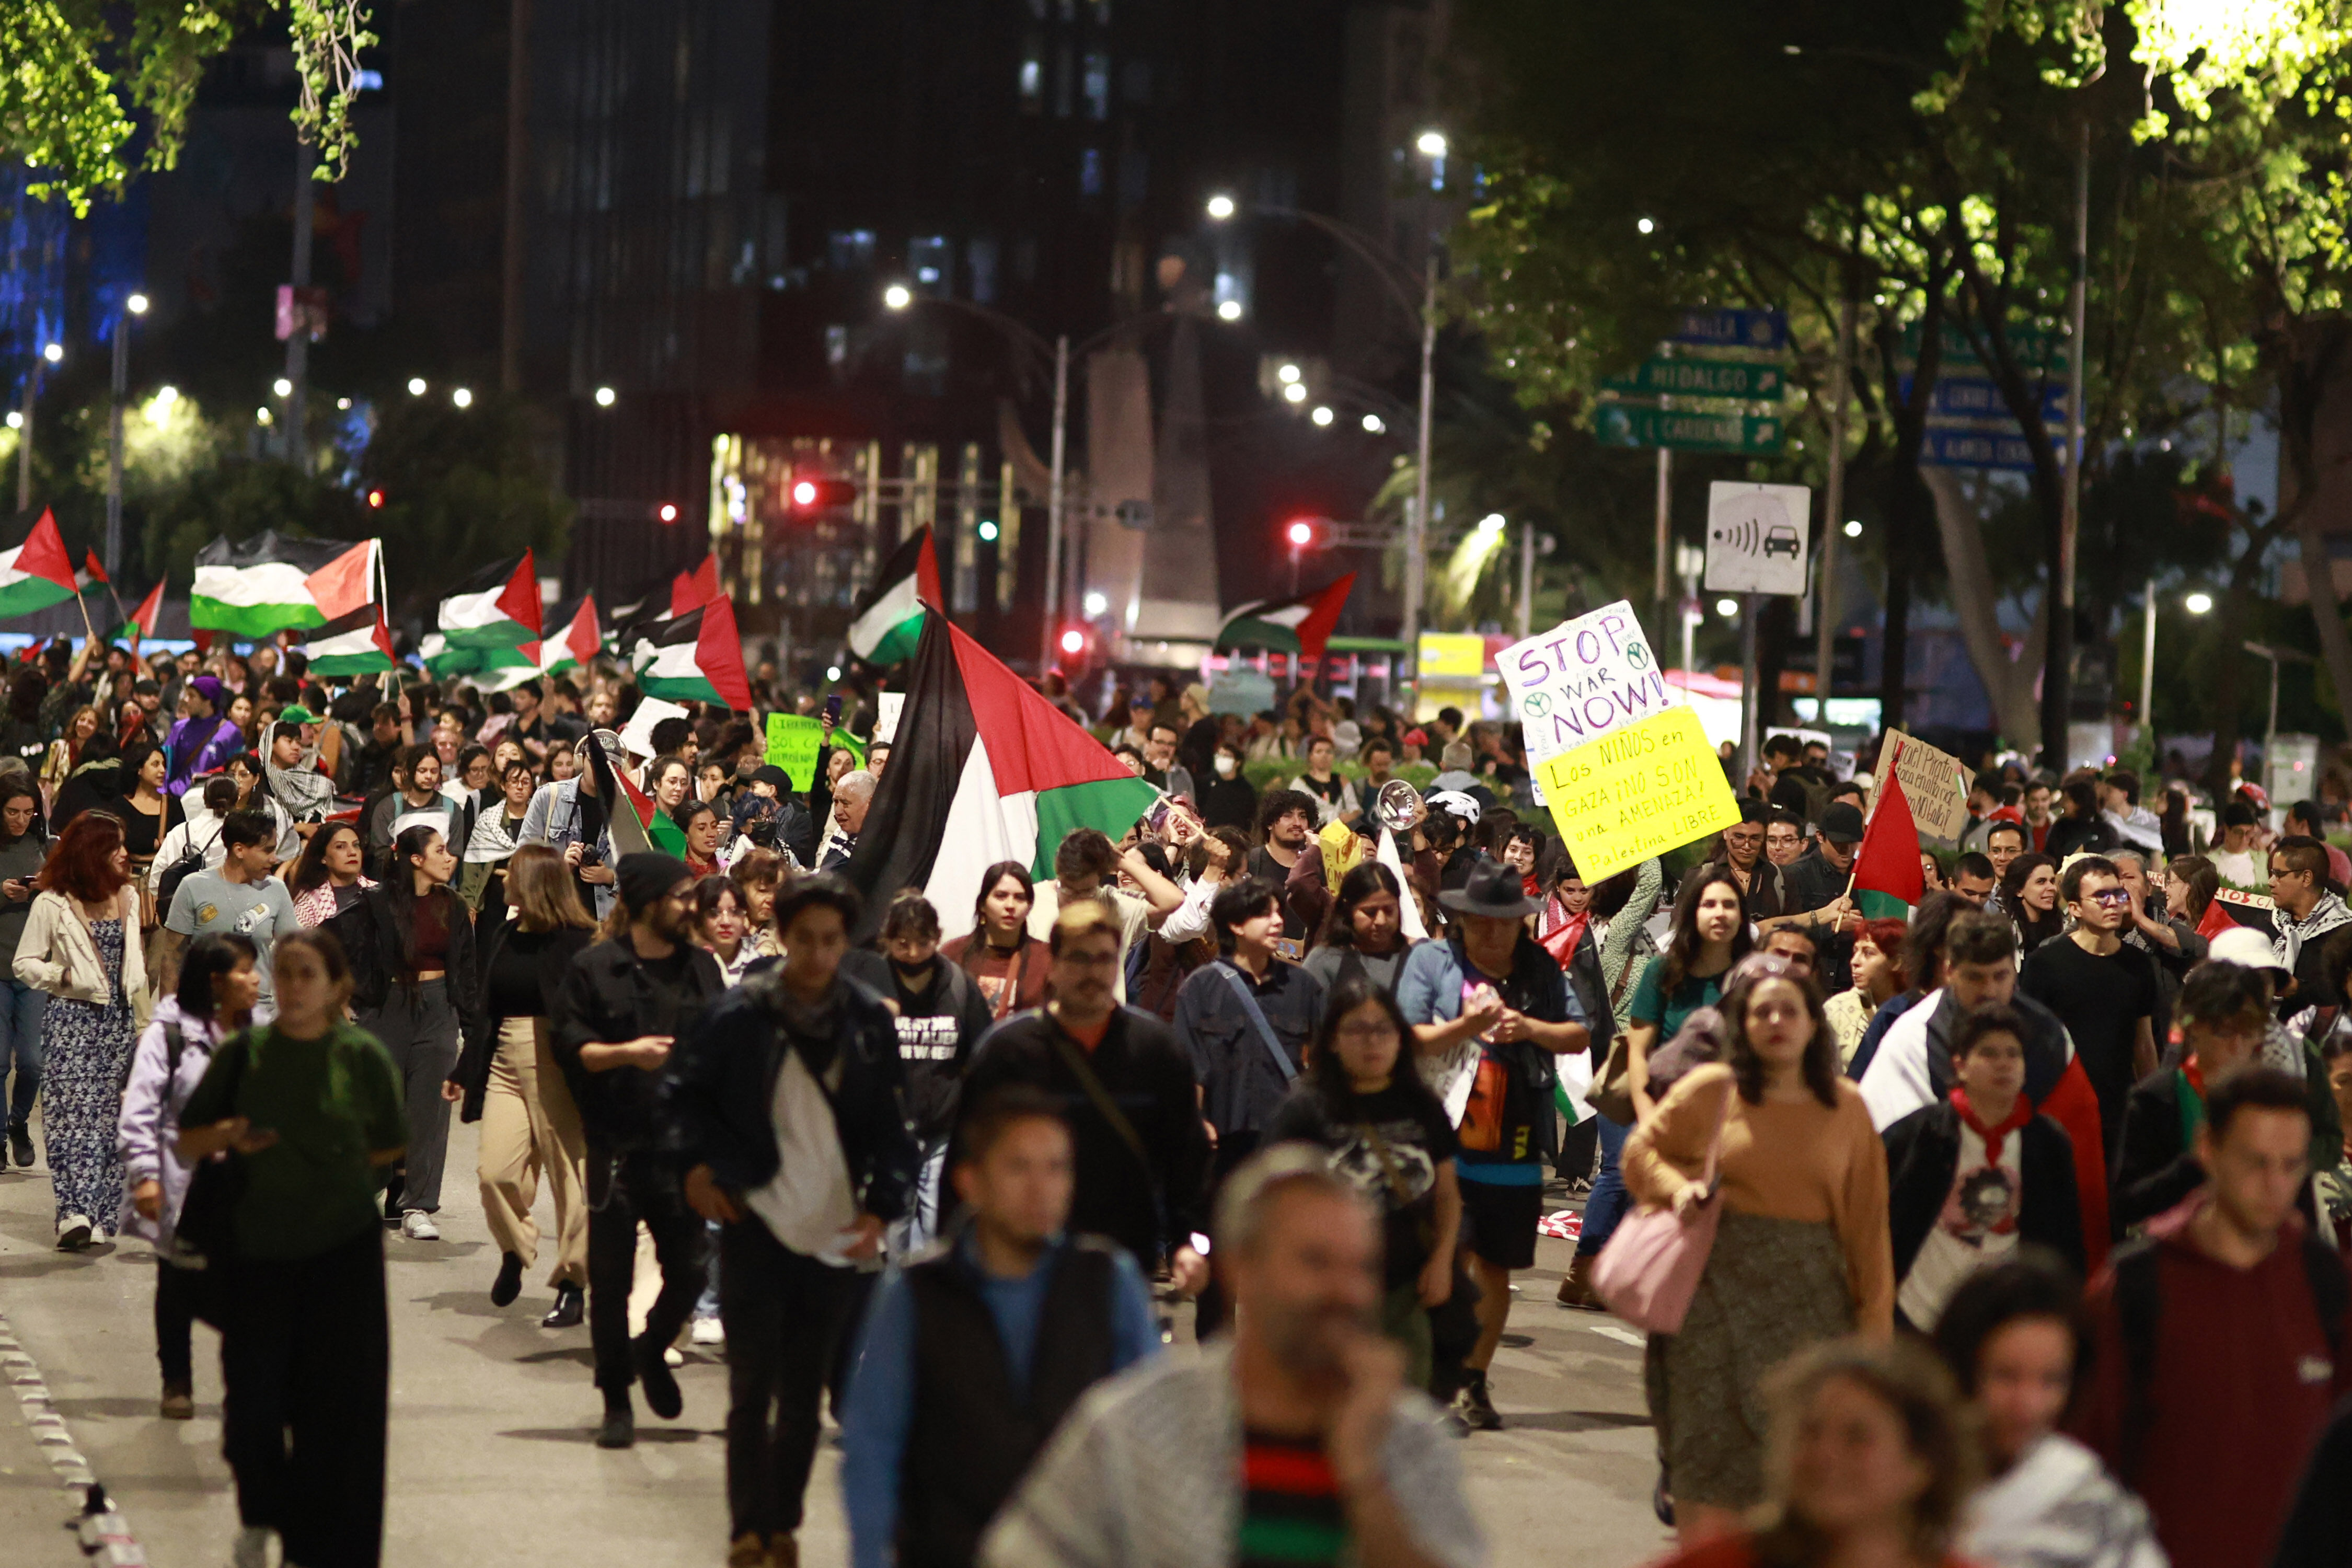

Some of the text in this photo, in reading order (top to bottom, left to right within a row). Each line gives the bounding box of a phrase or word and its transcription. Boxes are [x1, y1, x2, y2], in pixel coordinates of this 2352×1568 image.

[1651, 364, 1747, 392] HIDALGO
[1519, 616, 1625, 688] STOP
[1553, 670, 1669, 744] NOW!
[1560, 667, 1616, 700] WAR
[1550, 729, 1684, 789] Los NIÑOS en
[1564, 755, 1699, 818] GAZA ¡NO SON
[1892, 734, 1923, 768] Irael
[1922, 748, 1953, 784] Pirata
[1895, 765, 1914, 785] taca
[1576, 781, 1704, 841] una AMENAZA!
[1587, 803, 1722, 871] Palestina LIBRE
